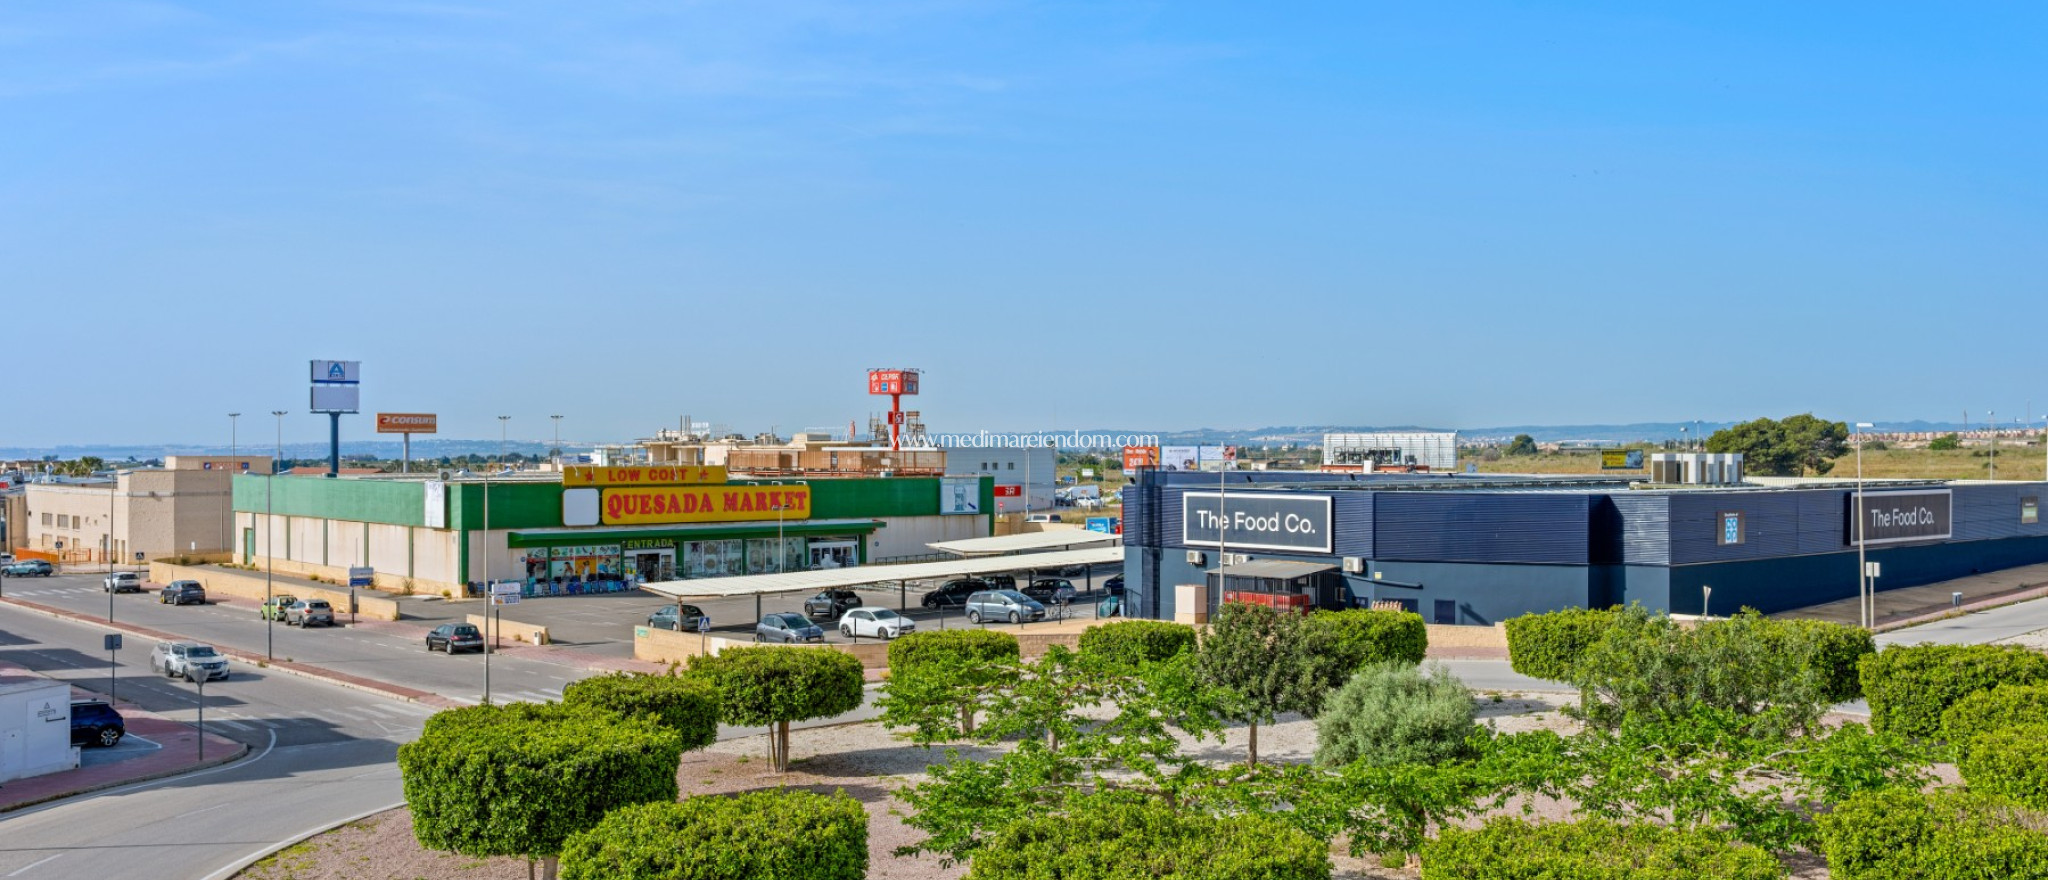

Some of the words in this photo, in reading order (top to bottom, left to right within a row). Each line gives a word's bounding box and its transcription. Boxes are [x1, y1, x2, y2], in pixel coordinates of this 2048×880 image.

[608, 469, 641, 482] LOW
[648, 468, 688, 482] COST
[607, 493, 714, 519] QUESADA
[723, 491, 807, 512] MARKET
[1196, 509, 1230, 530] The
[1234, 511, 1280, 532] Food
[1285, 512, 1316, 535] Co.
[1871, 508, 1891, 528] The
[1892, 506, 1917, 527] Food
[1919, 506, 1935, 525] Co.
[627, 538, 674, 549] ENTRADA
